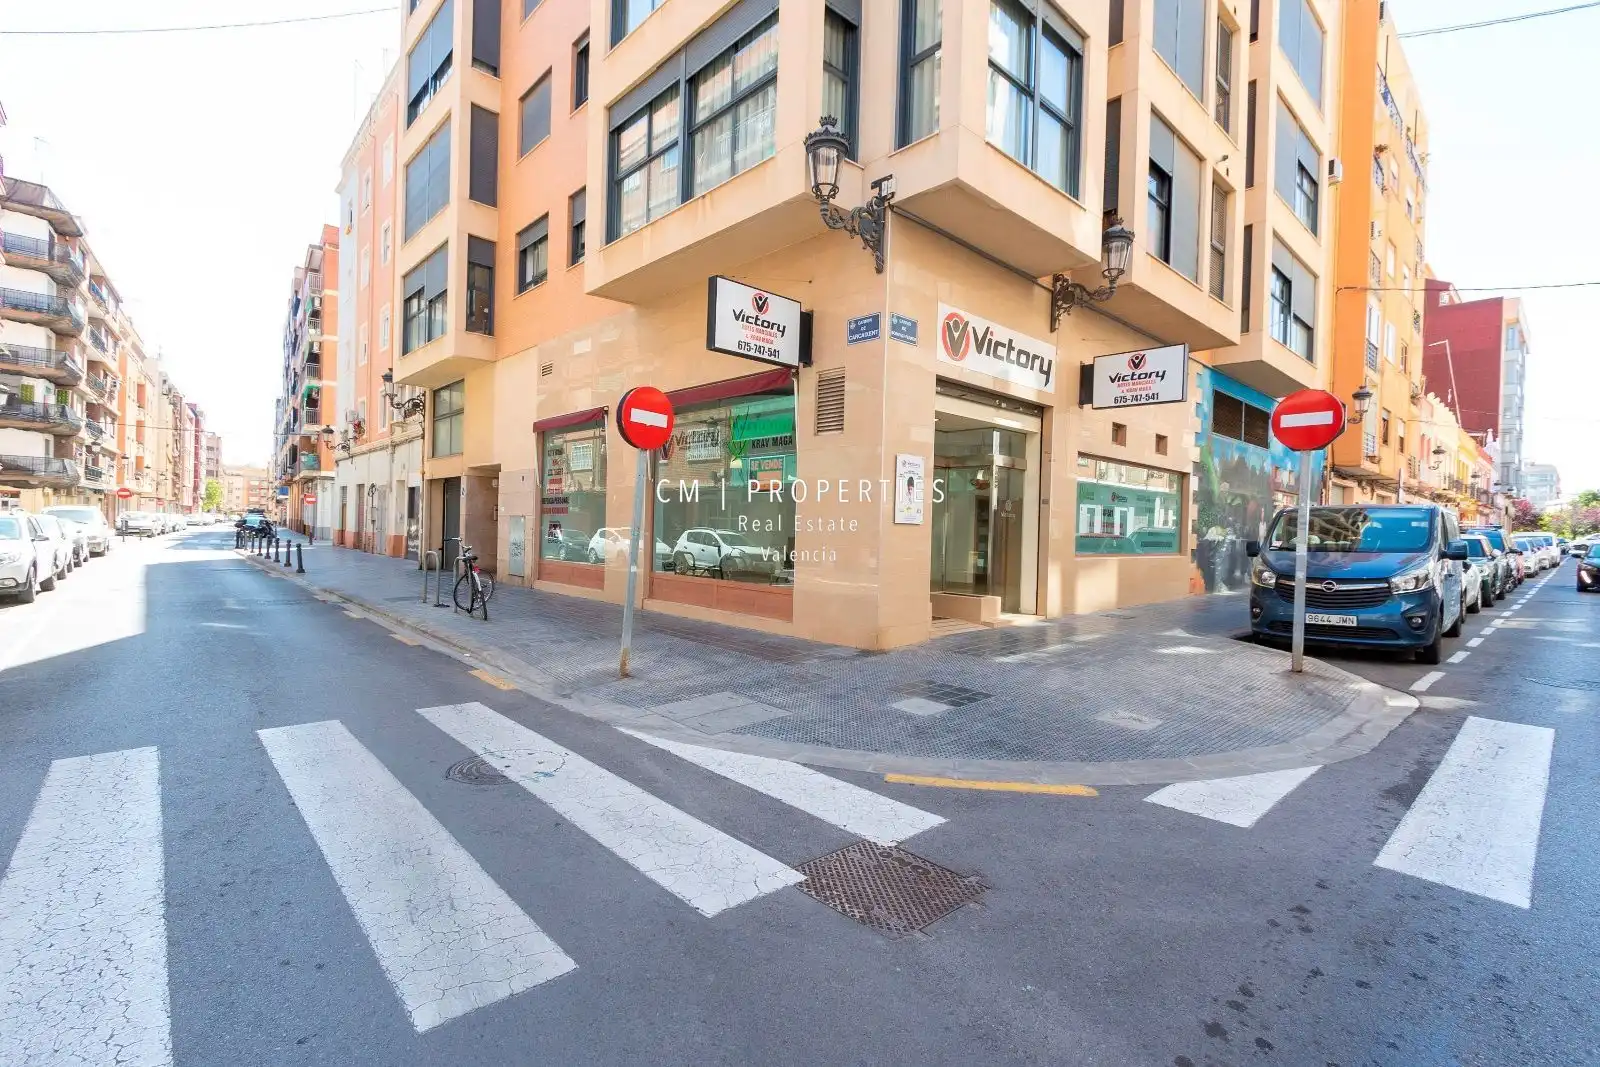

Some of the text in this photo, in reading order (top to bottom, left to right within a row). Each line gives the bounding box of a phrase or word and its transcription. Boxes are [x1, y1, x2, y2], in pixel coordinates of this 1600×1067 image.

[733, 309, 786, 338] Victory
[737, 340, 780, 359] 675-747-541
[972, 326, 1053, 387] Victory
[1108, 370, 1167, 384] Victory
[1114, 392, 1159, 404] 675-747-541
[751, 435, 793, 449] KRAV MAGA
[760, 458, 783, 470] VENDE
[1307, 614, 1354, 625] 9644 JMN
